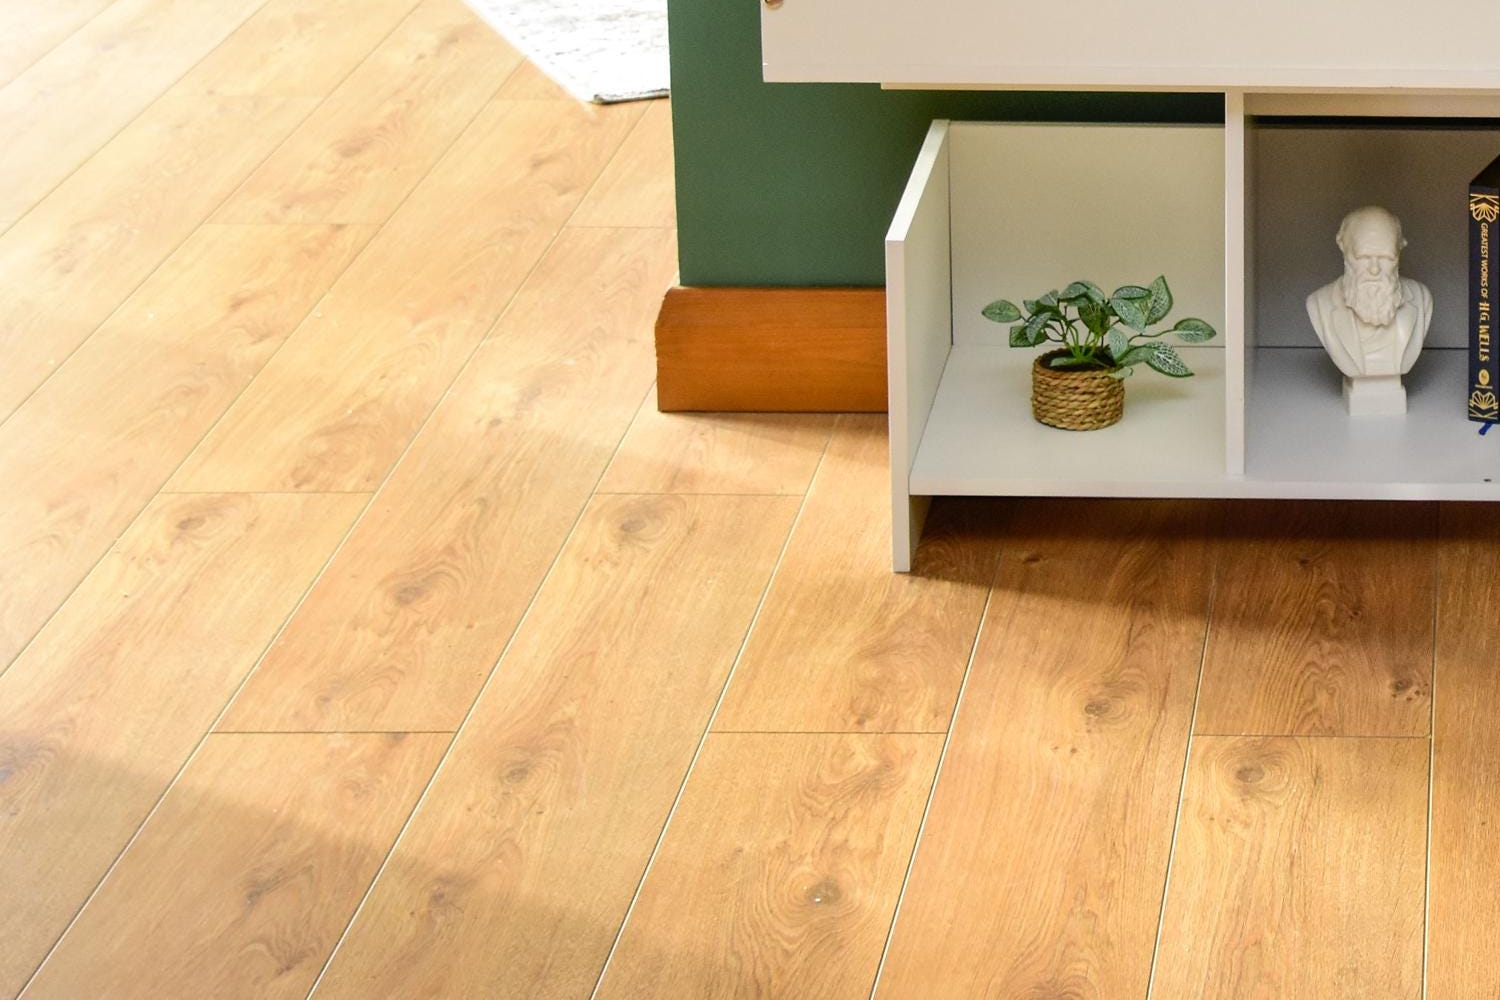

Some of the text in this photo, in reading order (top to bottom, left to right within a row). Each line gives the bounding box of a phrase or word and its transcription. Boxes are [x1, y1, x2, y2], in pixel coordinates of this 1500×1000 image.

[1481, 222, 1489, 258] GREATEST
[1480, 259, 1489, 287] WORKS
[1480, 288, 1489, 299] OF
[1479, 324, 1490, 362] WELLS
